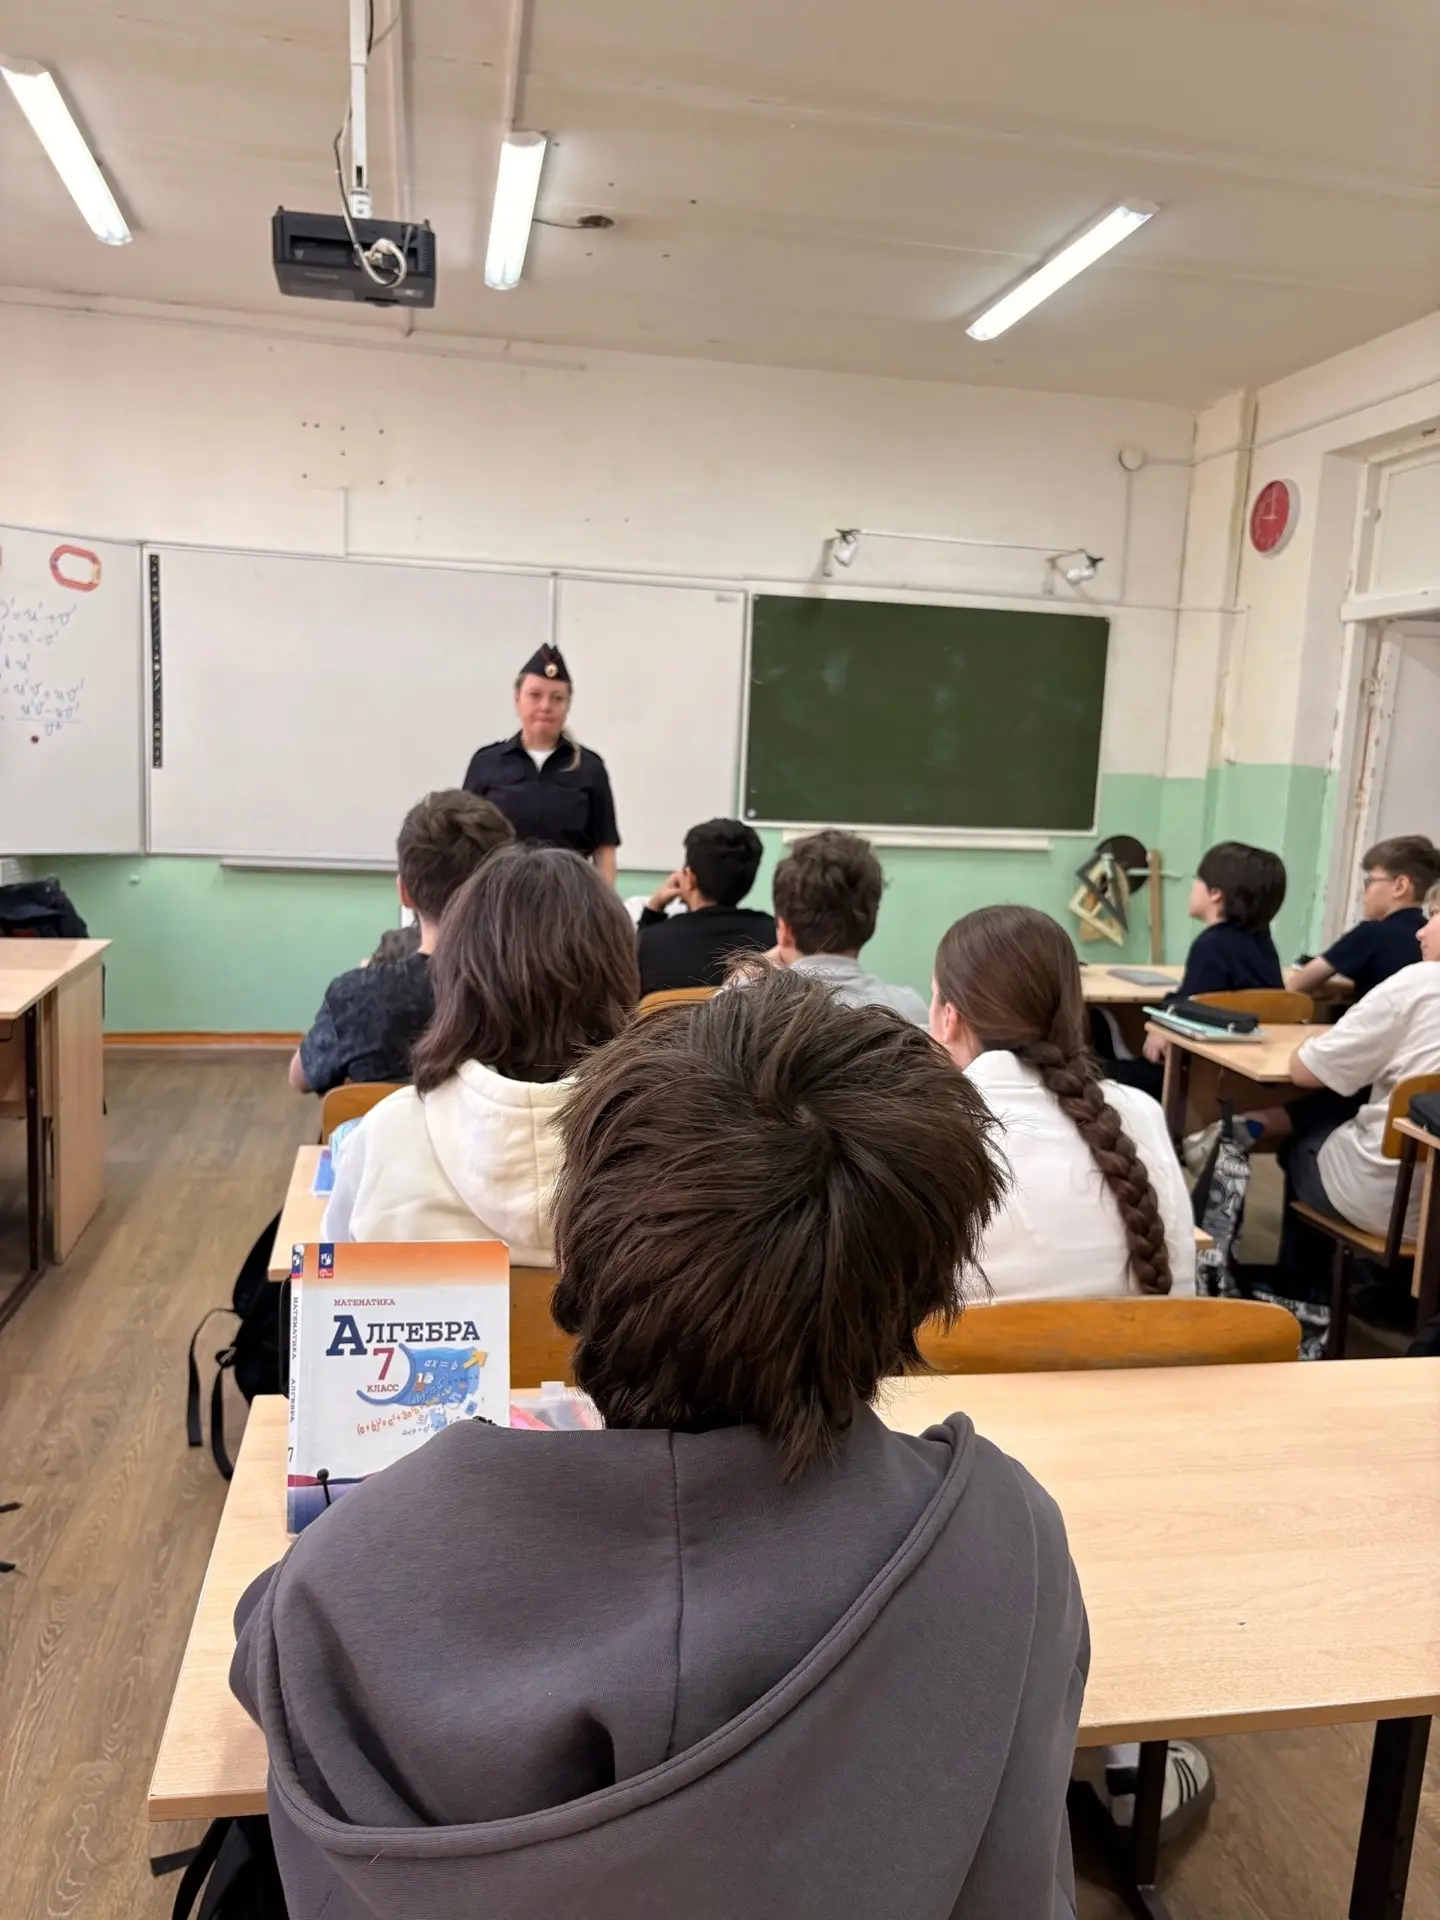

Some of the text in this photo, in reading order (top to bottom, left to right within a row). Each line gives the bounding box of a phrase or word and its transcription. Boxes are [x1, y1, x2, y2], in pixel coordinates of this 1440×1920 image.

[291, 1296, 299, 1360] МАТЕМАТИКА
[326, 1315, 480, 1356] АЛГЕБРА
[373, 1347, 394, 1380] 7
[366, 1384, 399, 1393] КЛАСС
[288, 1447, 294, 1462] 7
